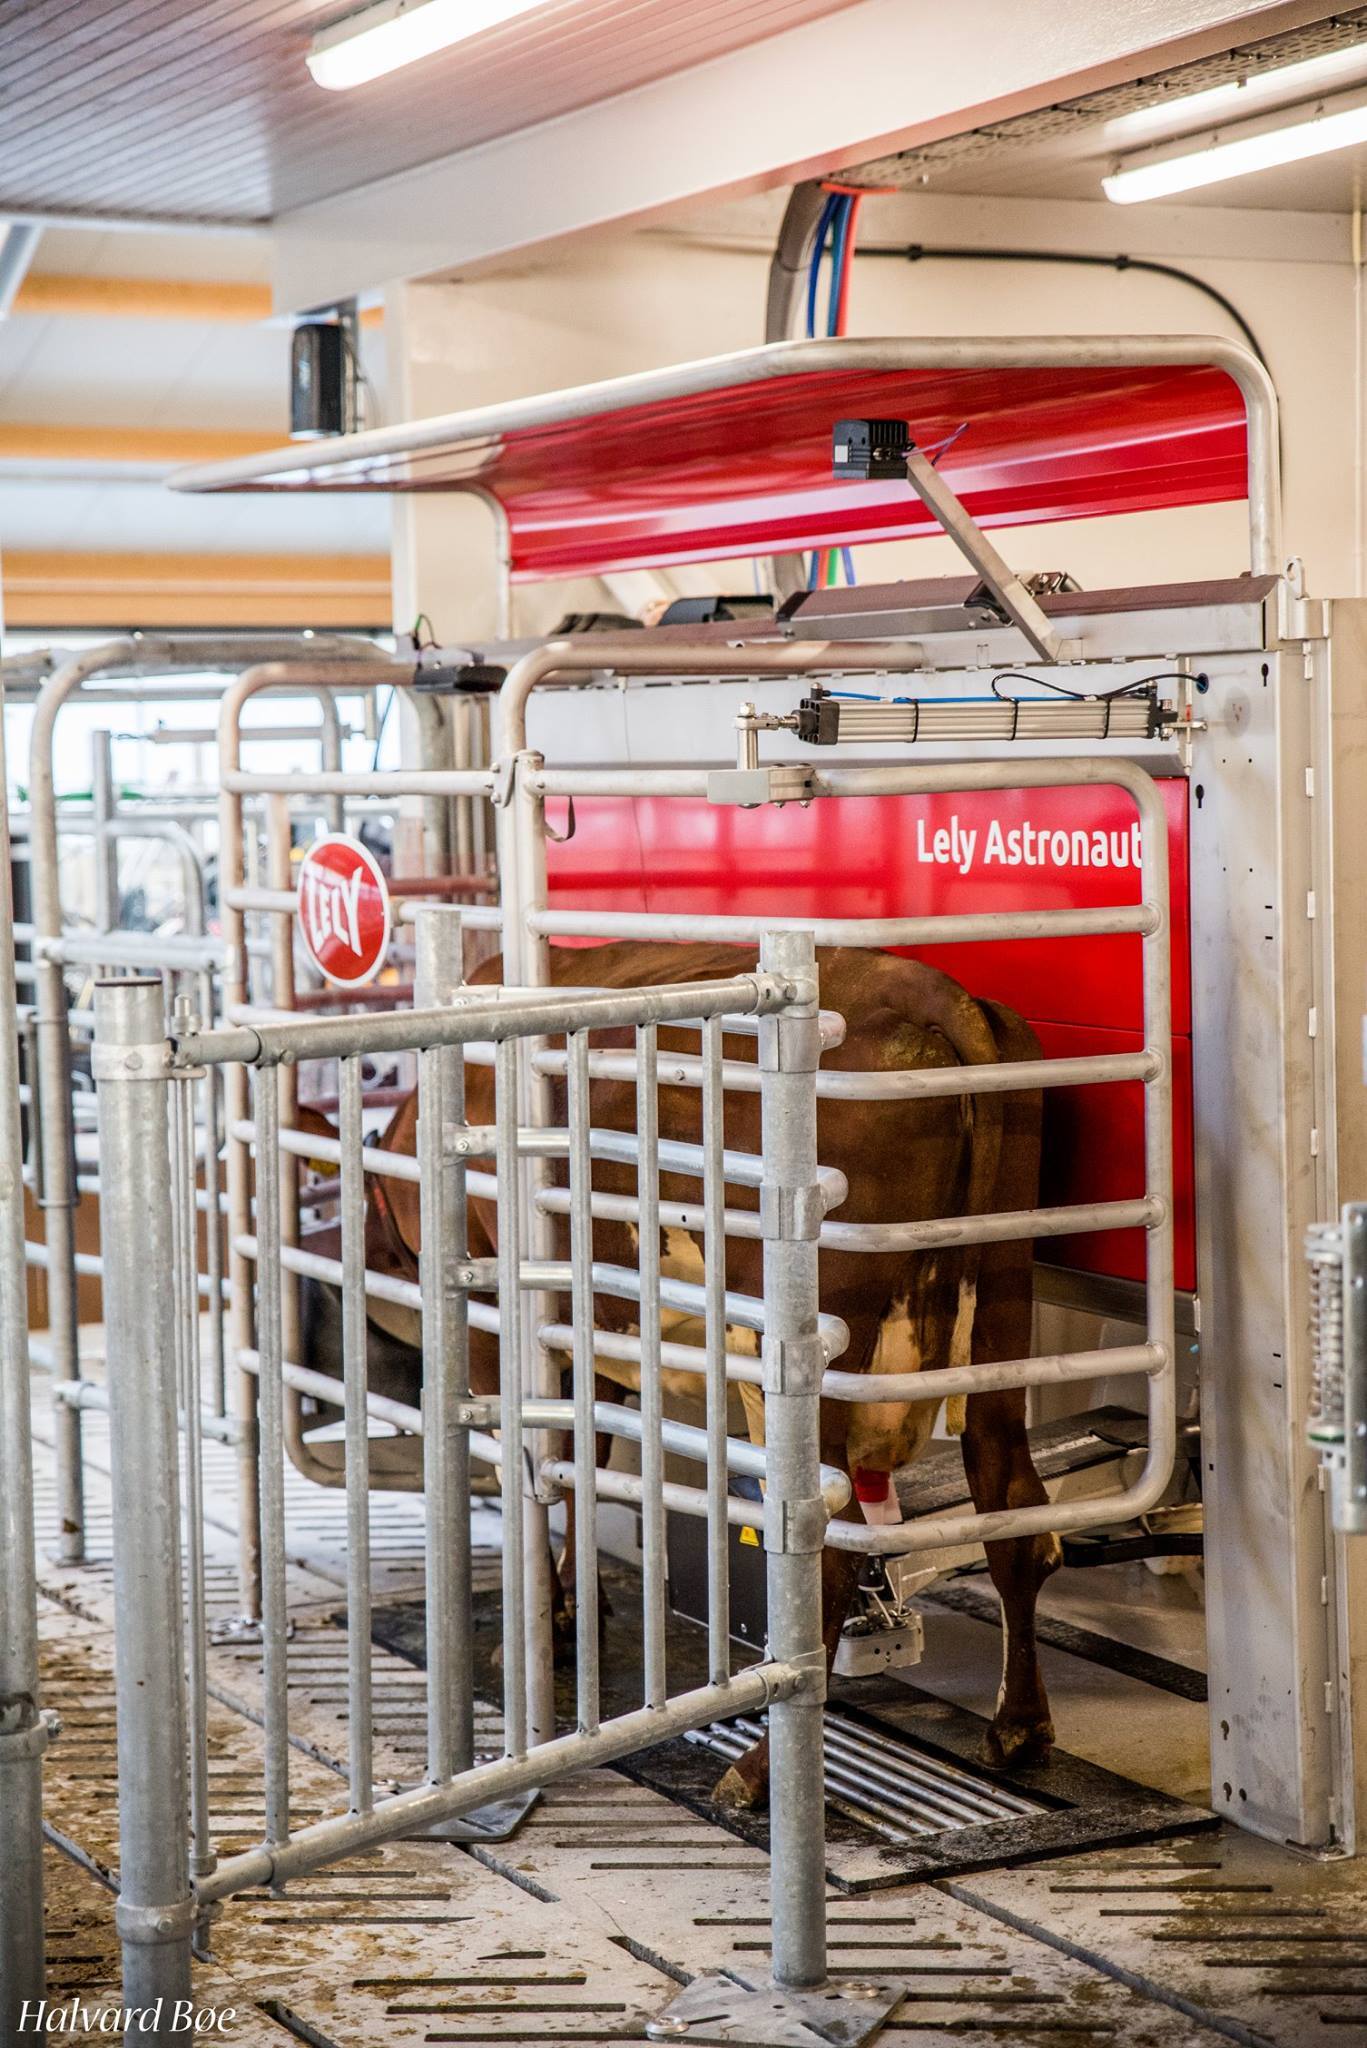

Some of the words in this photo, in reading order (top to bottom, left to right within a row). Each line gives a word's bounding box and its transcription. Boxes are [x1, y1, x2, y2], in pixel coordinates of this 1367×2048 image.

[917, 815, 977, 875] Lely
[984, 819, 1142, 868] Astronaut
[304, 864, 363, 957] LELY
